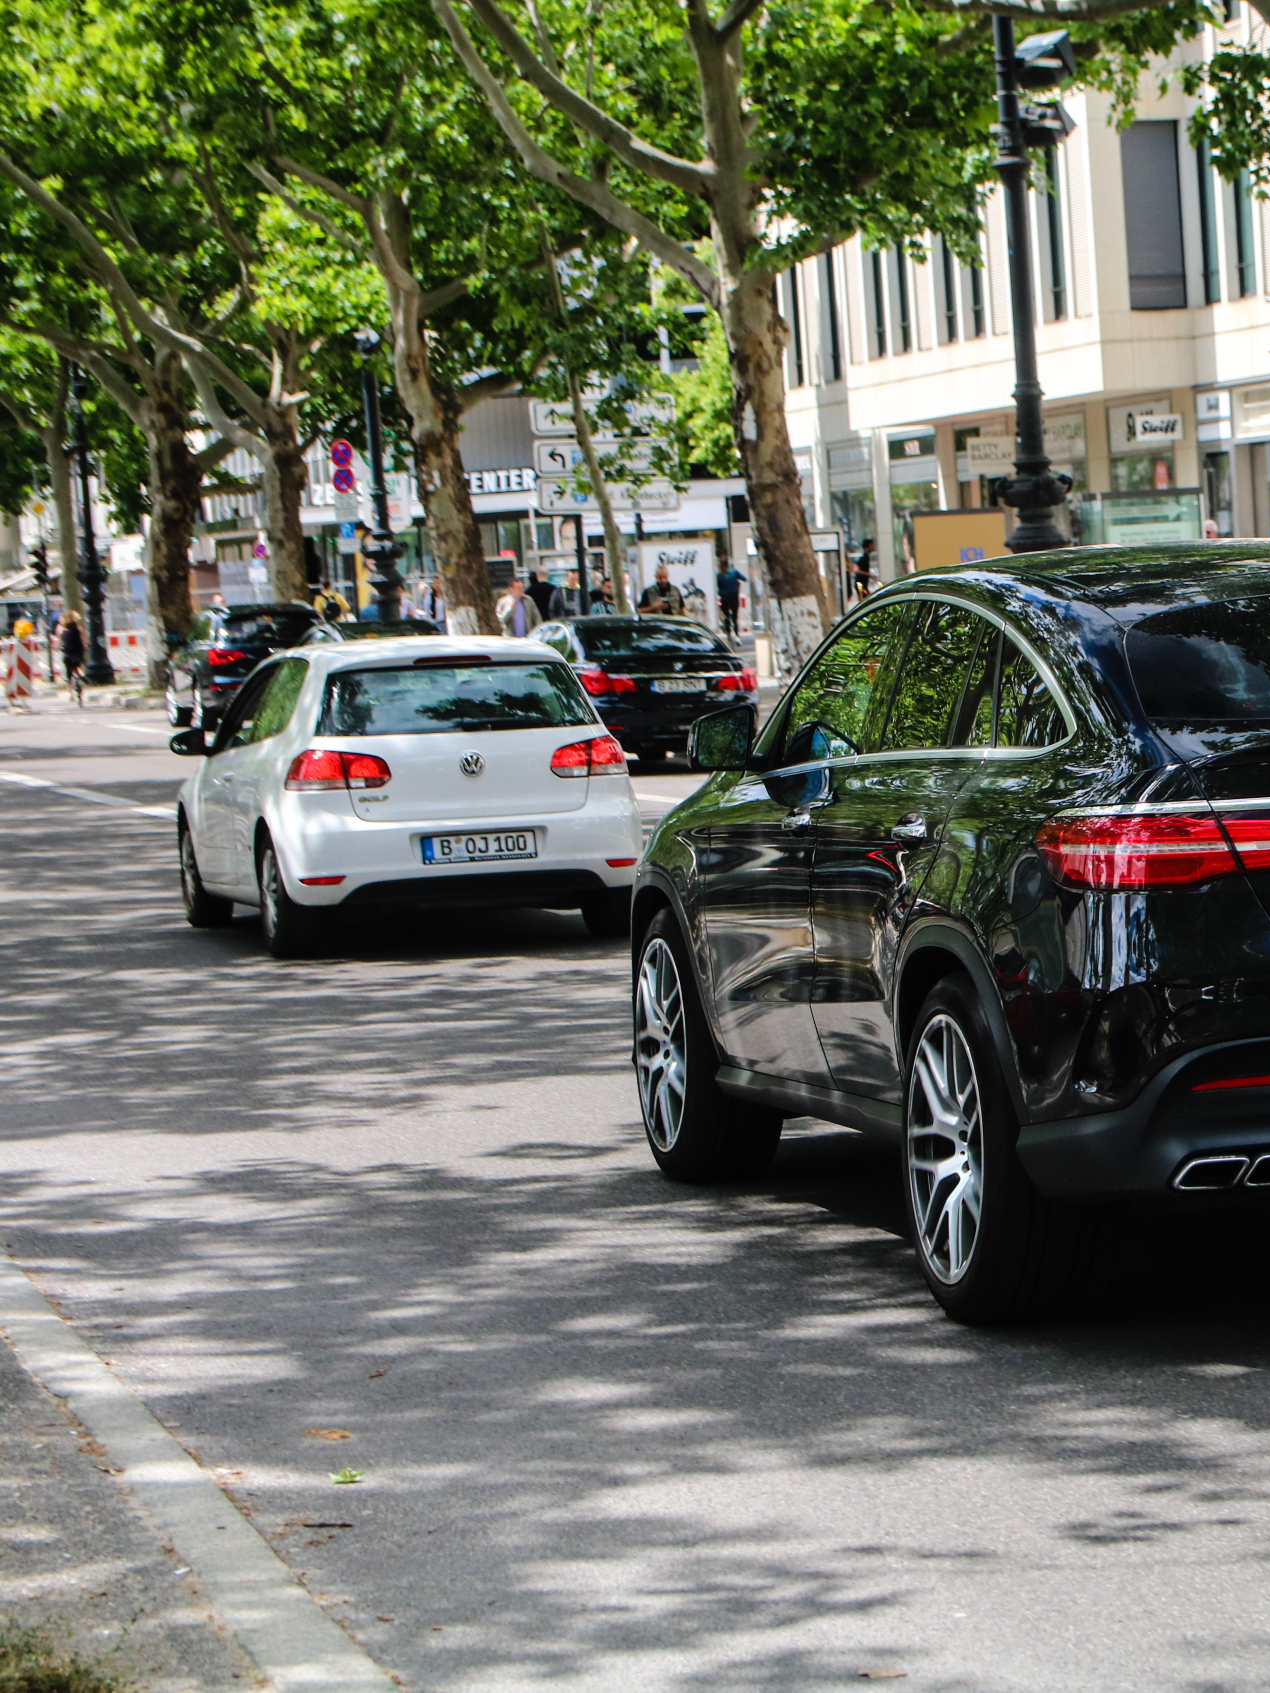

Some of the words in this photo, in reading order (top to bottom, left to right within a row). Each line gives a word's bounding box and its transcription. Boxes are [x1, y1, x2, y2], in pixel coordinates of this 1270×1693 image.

[1141, 419, 1178, 435] Steiff
[970, 442, 998, 451] BETTY
[970, 452, 1012, 461] BARCLAY
[657, 550, 698, 567] Steiff
[441, 839, 453, 856] B
